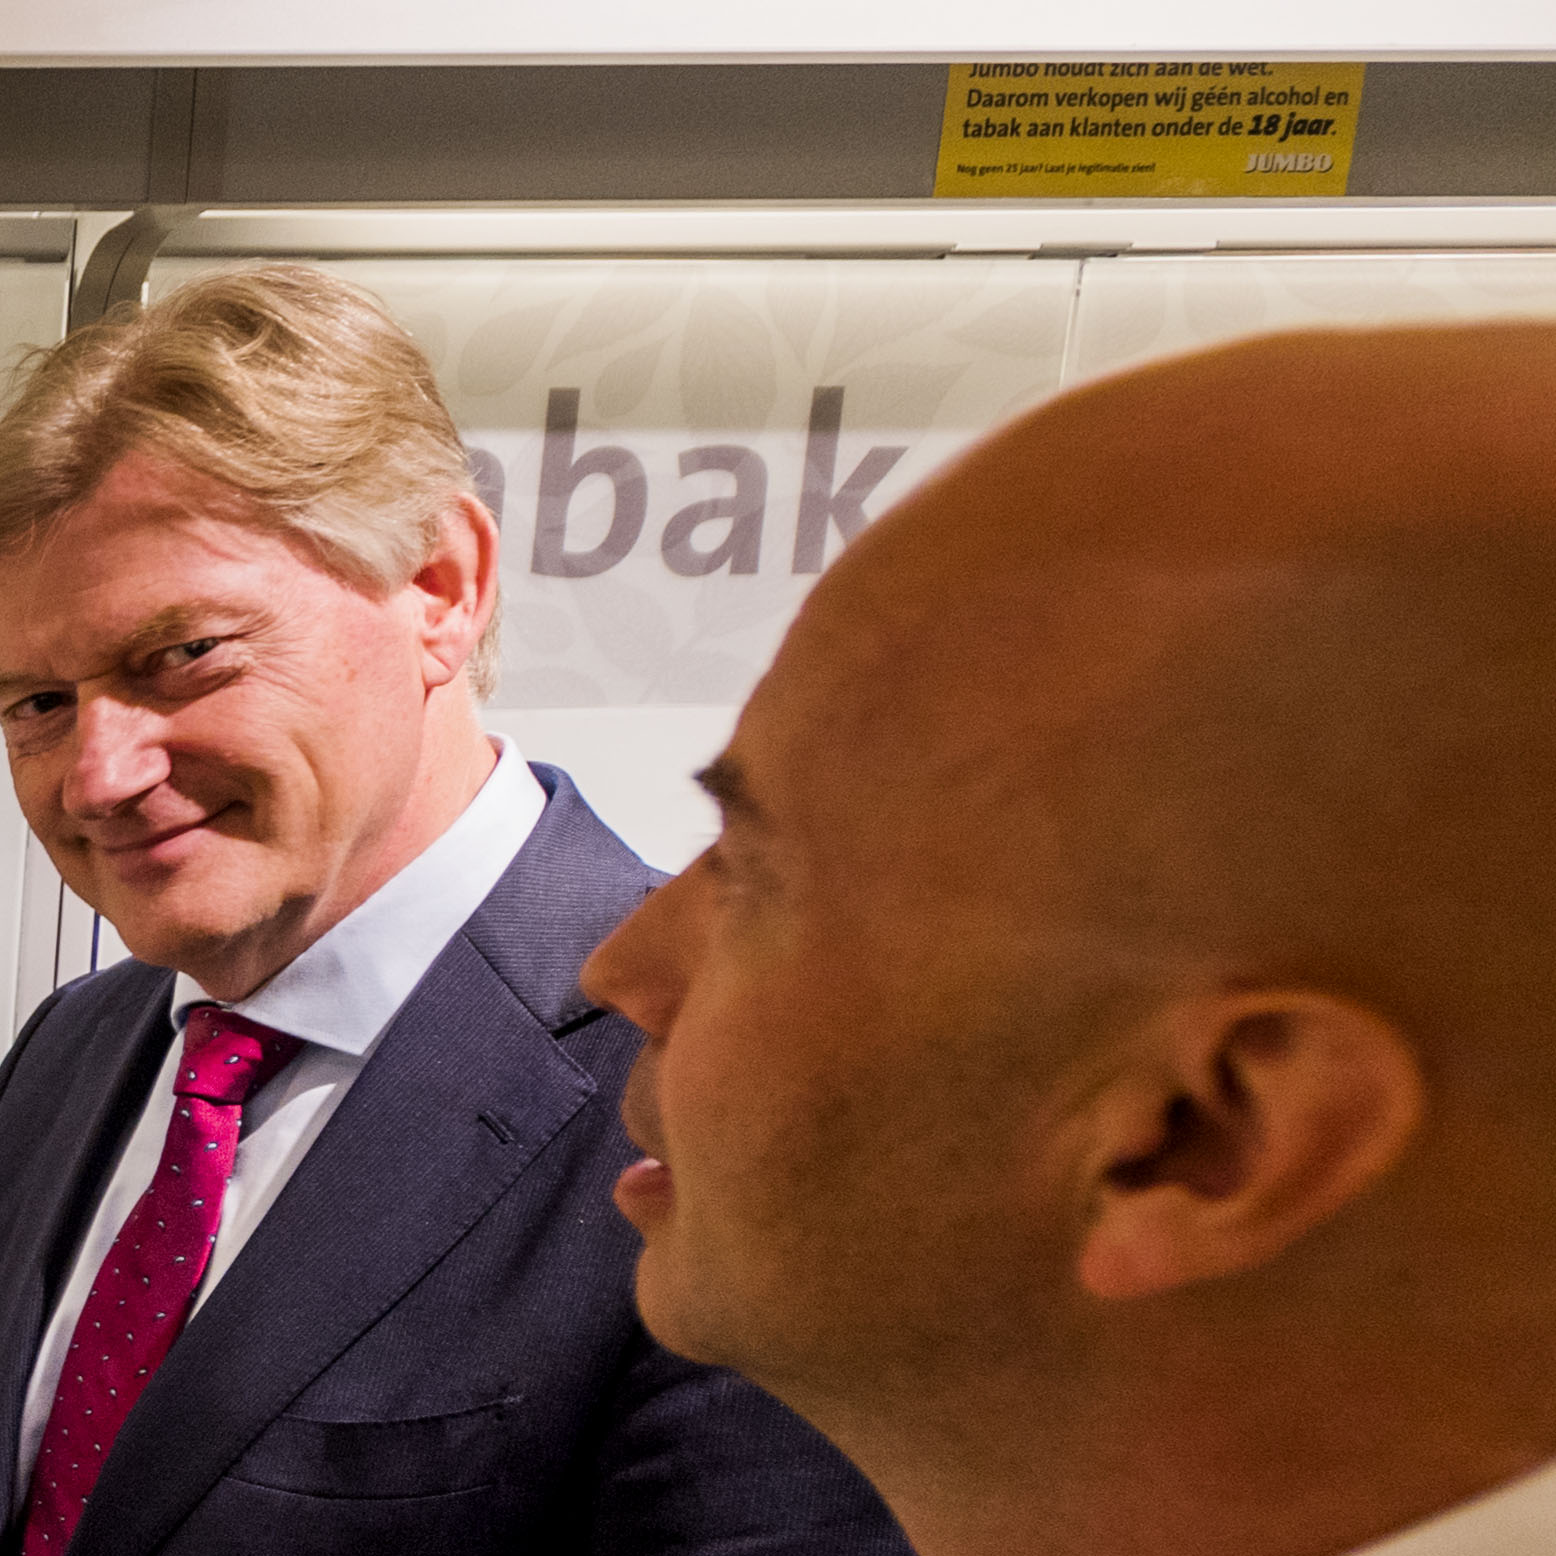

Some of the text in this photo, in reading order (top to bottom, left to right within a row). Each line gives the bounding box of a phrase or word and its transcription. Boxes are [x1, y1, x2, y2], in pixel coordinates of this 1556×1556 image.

[969, 62, 1274, 78] Jumbo houdt zich aan de wet.
[967, 85, 1349, 114] Daarom verkopen wij géén alcohol en
[963, 113, 1337, 142] tabak aan klanten onder de 18 jaar.
[1243, 152, 1334, 174] JUMBO
[466, 386, 909, 577] bak
